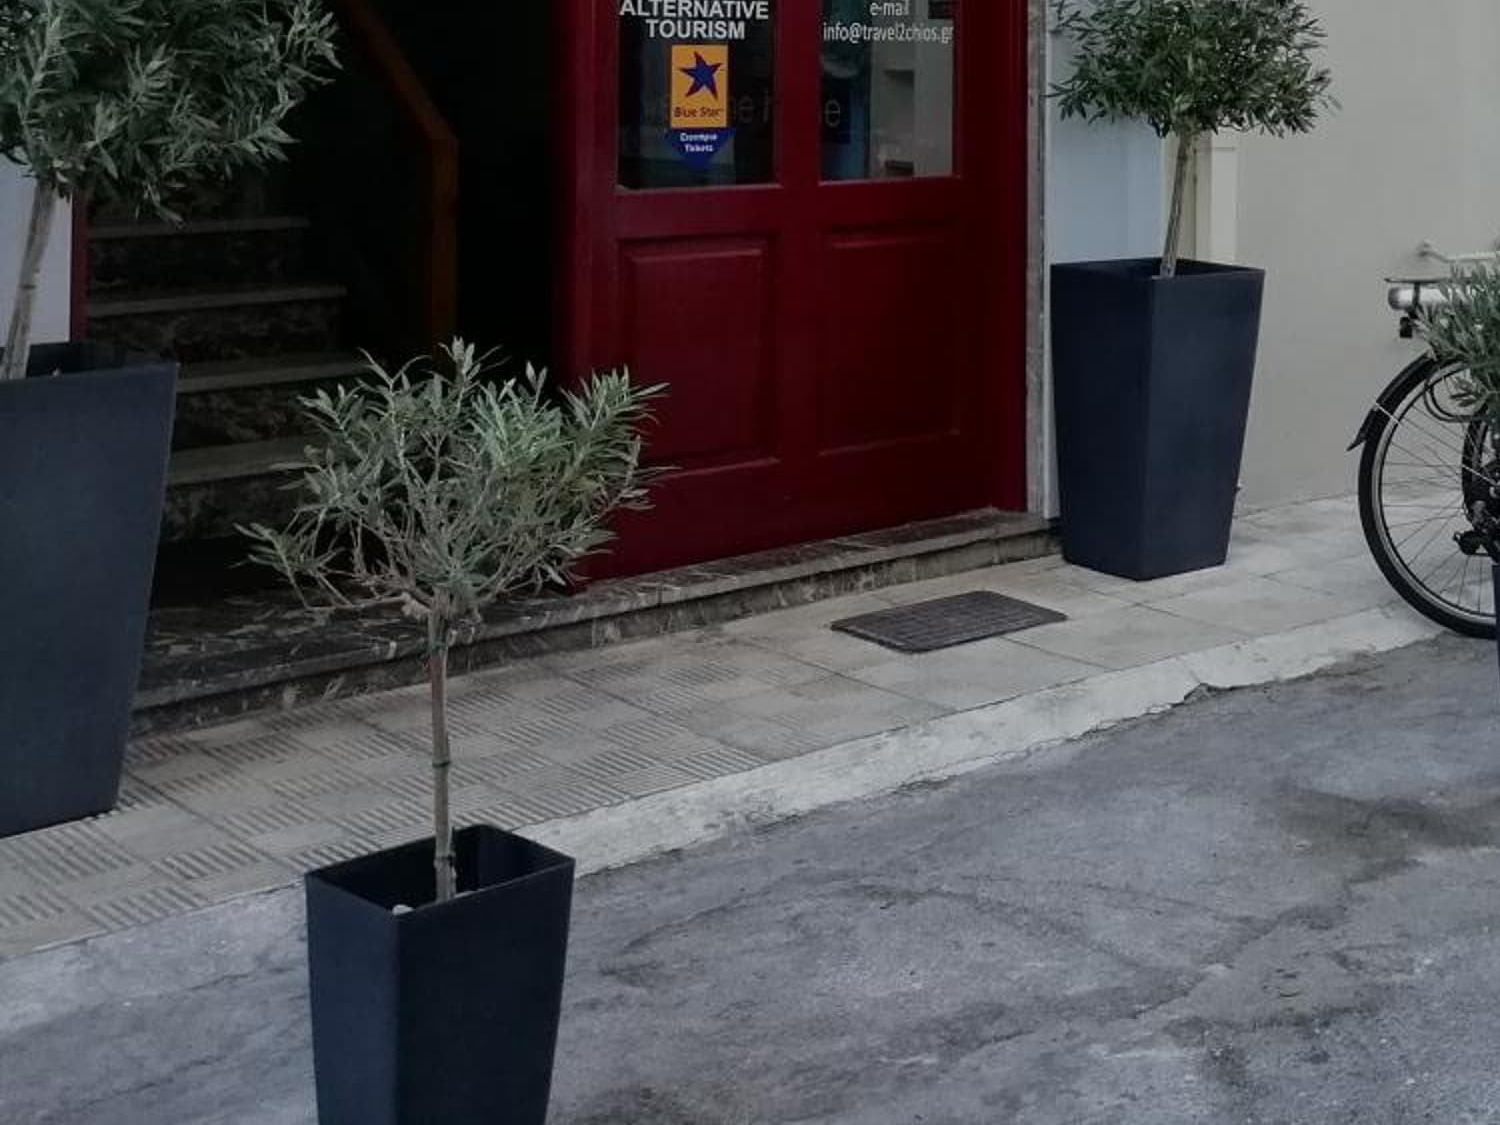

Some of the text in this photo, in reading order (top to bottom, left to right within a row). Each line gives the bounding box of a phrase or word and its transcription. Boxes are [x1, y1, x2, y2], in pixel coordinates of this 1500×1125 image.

[870, 0, 910, 16] e-mail
[646, 19, 745, 40] TOURISM
[674, 106, 697, 118] Blue
[699, 106, 721, 118] Star
